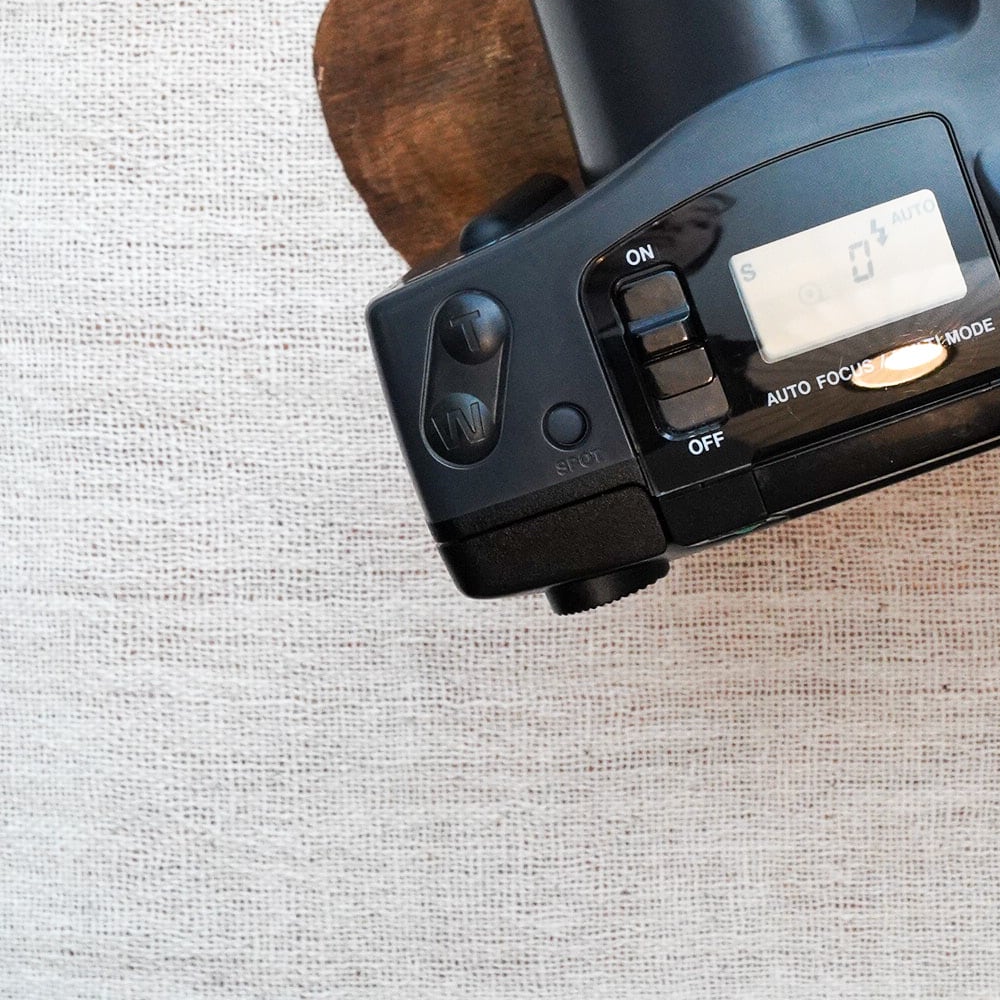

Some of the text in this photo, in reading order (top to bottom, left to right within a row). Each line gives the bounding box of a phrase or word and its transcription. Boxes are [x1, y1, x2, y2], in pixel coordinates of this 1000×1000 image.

[891, 199, 936, 225] AUTO
[625, 244, 655, 267] ON
[740, 263, 757, 282] S
[450, 309, 481, 353] T
[767, 380, 811, 407] AUTO
[816, 359, 874, 390] FOCUS
[944, 318, 995, 346] MODE
[687, 431, 725, 457] OFF
